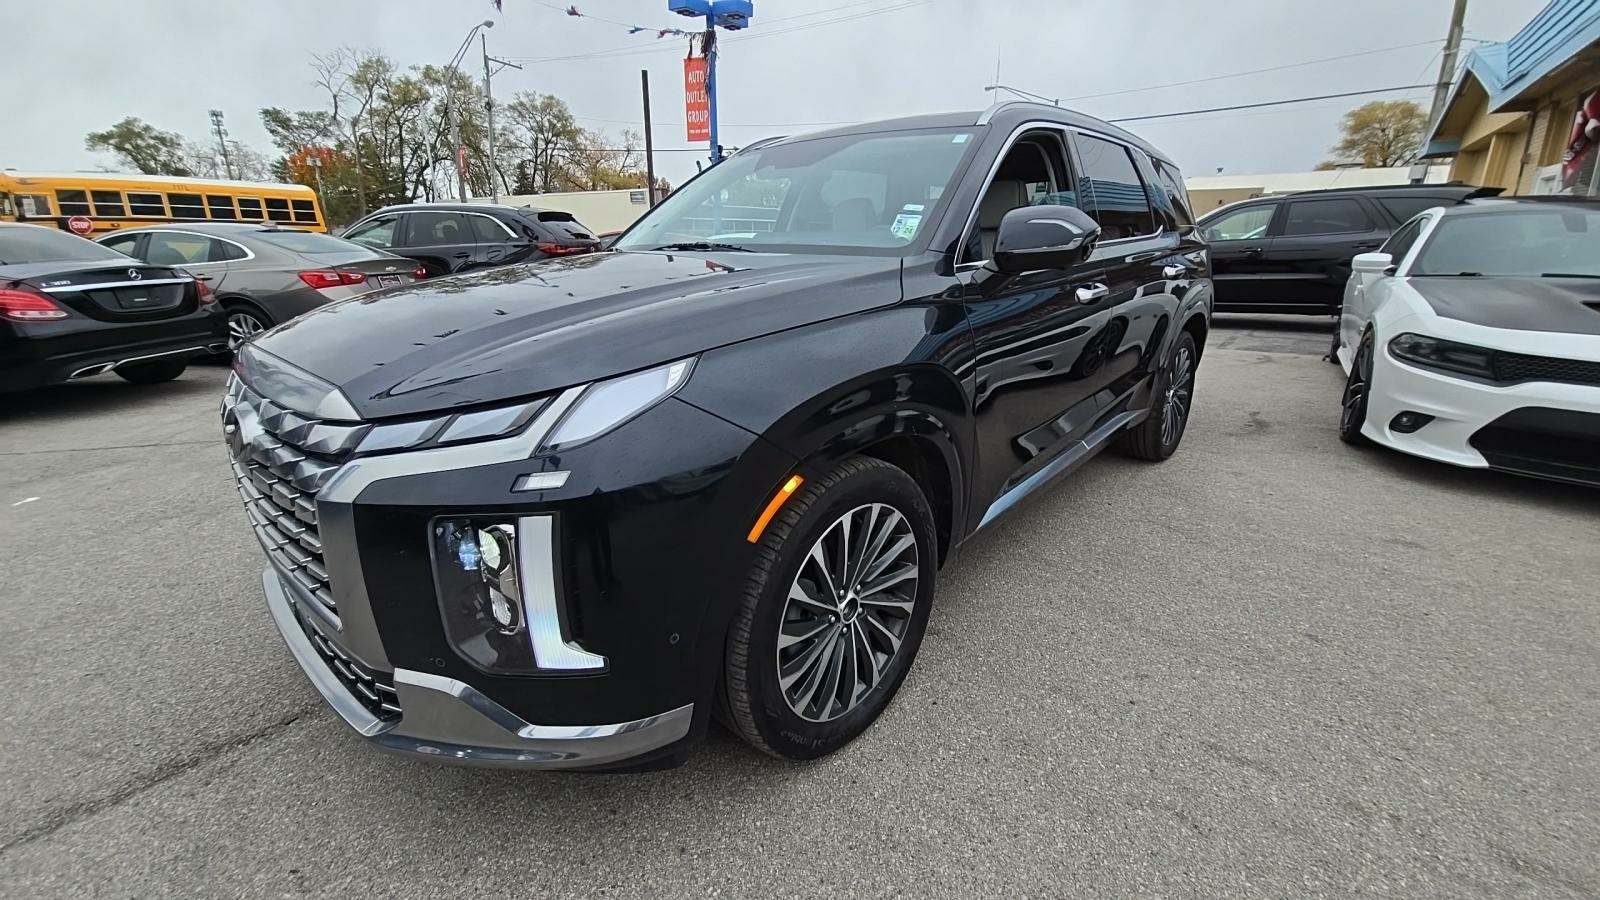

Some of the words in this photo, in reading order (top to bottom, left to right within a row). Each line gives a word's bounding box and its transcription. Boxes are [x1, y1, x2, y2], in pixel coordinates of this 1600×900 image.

[689, 71, 704, 83] AUTO
[688, 110, 708, 123] GROUP
[71, 221, 89, 229] STOP
